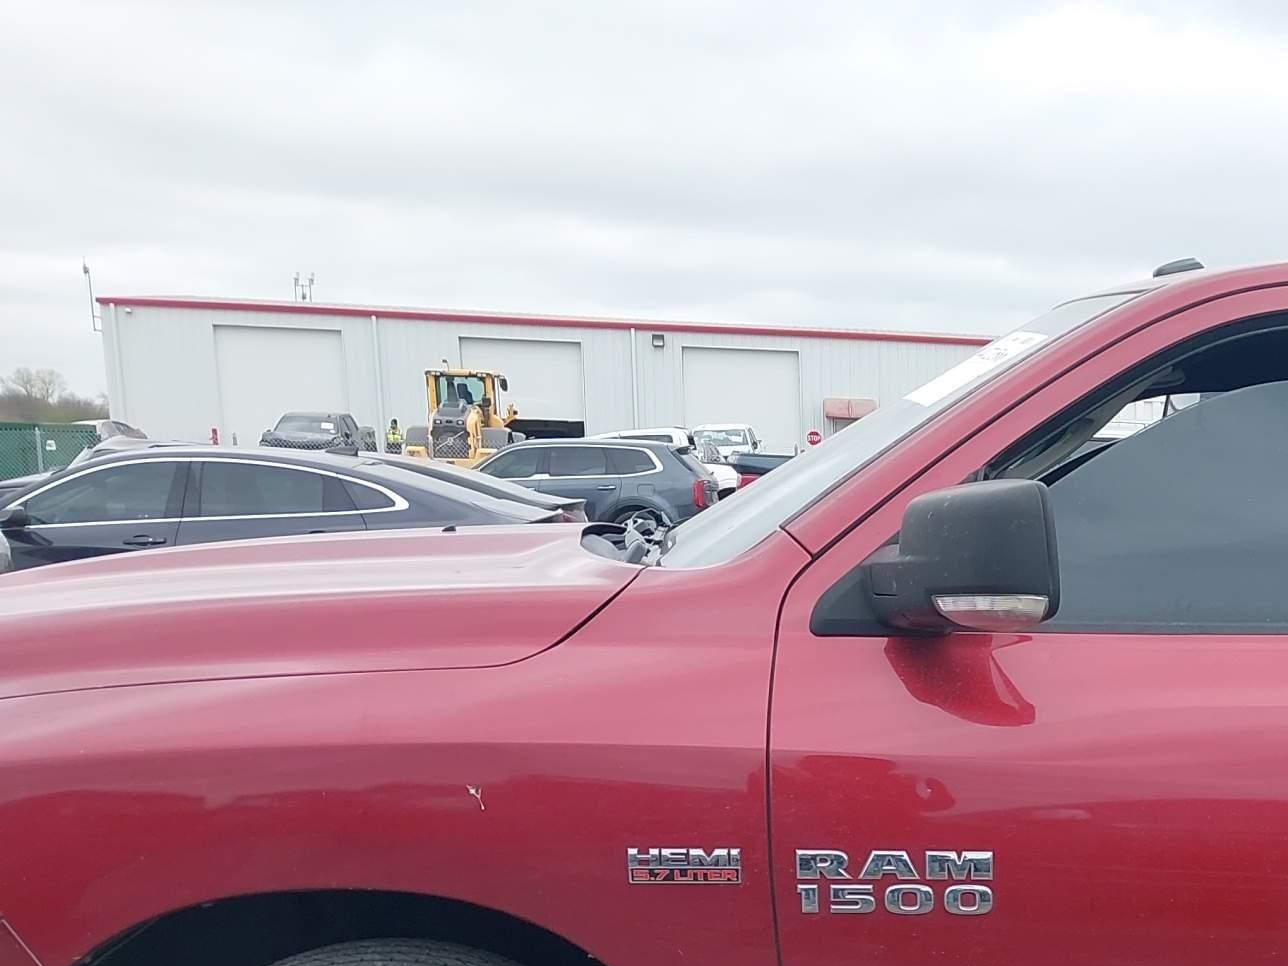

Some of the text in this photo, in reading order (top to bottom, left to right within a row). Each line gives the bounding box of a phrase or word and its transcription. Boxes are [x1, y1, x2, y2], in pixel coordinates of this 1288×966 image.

[627, 847, 741, 868] HEMI
[795, 848, 994, 881] RAM
[632, 869, 738, 881] 5.7 LITER
[796, 884, 993, 915] 1500
